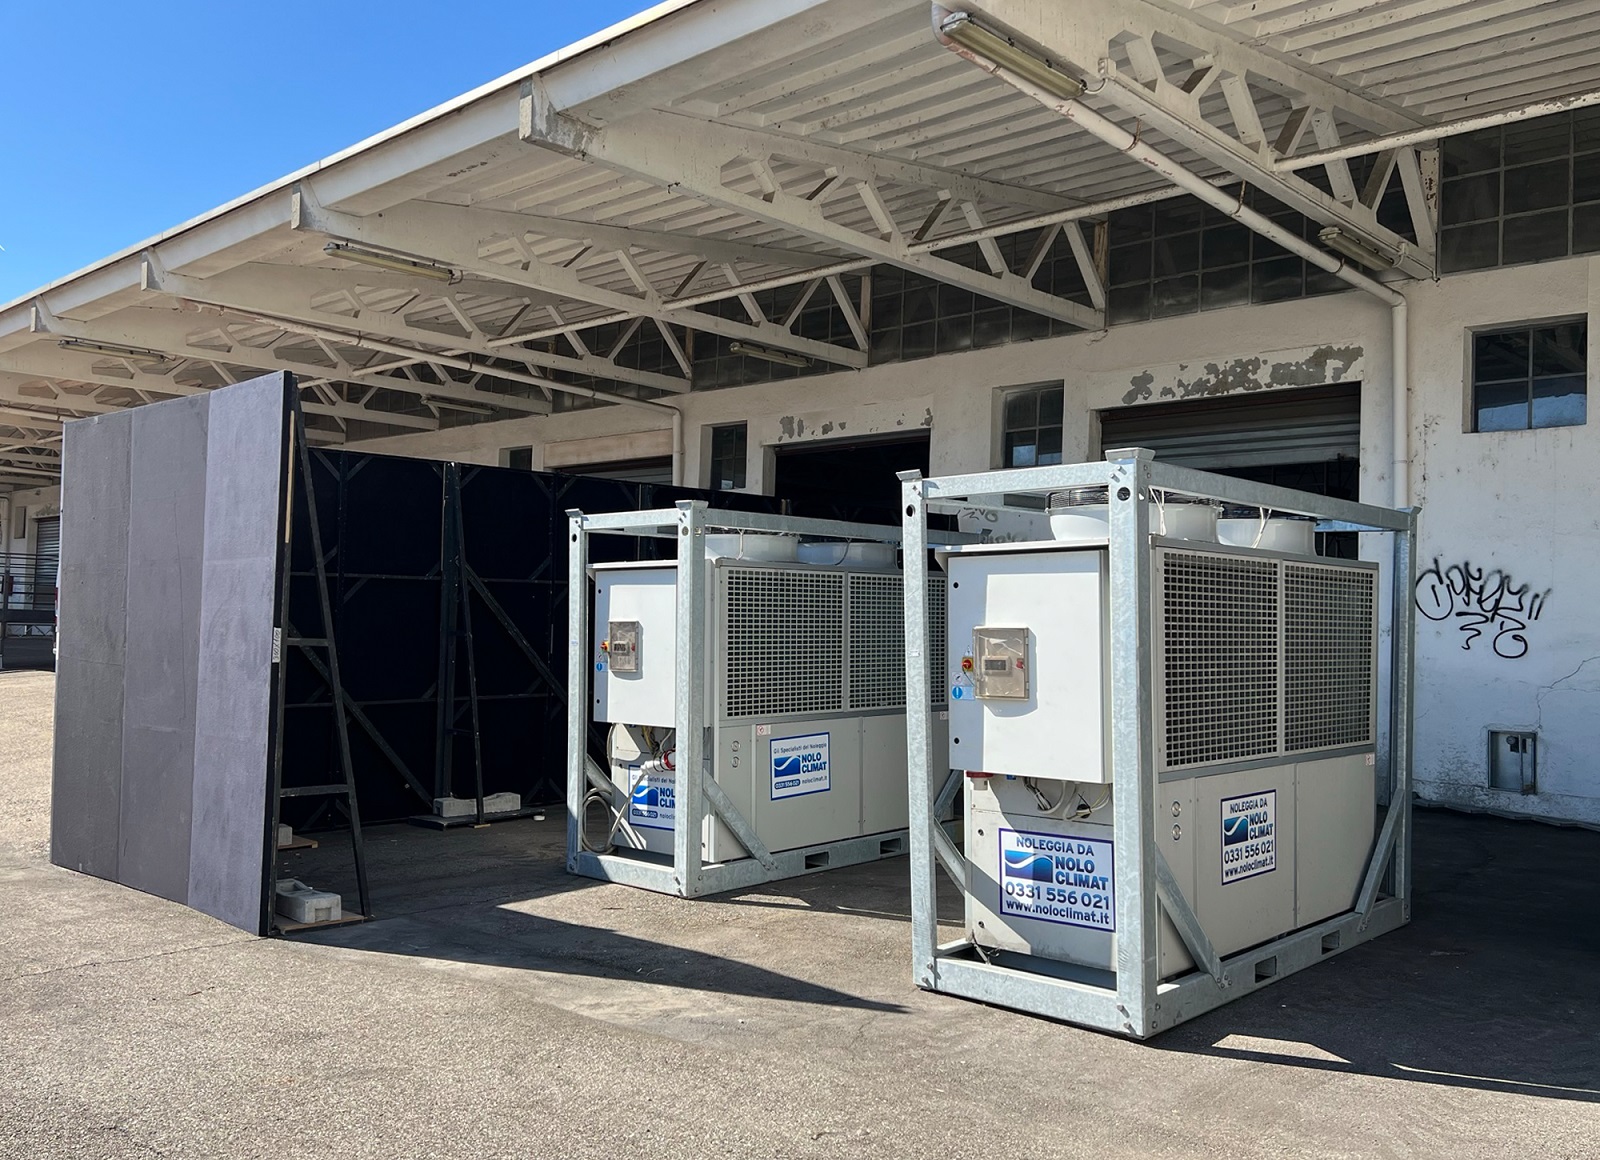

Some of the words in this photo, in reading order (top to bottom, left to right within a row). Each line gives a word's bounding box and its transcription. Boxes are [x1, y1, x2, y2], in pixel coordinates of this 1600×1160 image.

[802, 752, 822, 763] NOLO
[802, 762, 827, 773] CLIMAT
[660, 787, 675, 798] NOL
[1230, 801, 1259, 814] NOLEGGIA
[1260, 798, 1268, 808] DA
[1249, 810, 1268, 826] NOLO
[1249, 824, 1274, 840] CLIMAT
[1016, 837, 1074, 854] NOLEGGIA
[1077, 844, 1095, 857] DA
[1224, 848, 1243, 864] 0331
[1245, 843, 1260, 859] 556
[1261, 840, 1274, 854] 021
[1055, 856, 1095, 873] NOLO
[1225, 855, 1274, 878] www.noloclimat.it
[1055, 872, 1109, 890] CLIMAT
[1005, 881, 1041, 900] 0331
[1046, 887, 1078, 905] 556
[1081, 893, 1109, 910] 021
[1006, 900, 1109, 924] www.noloclimat.it
